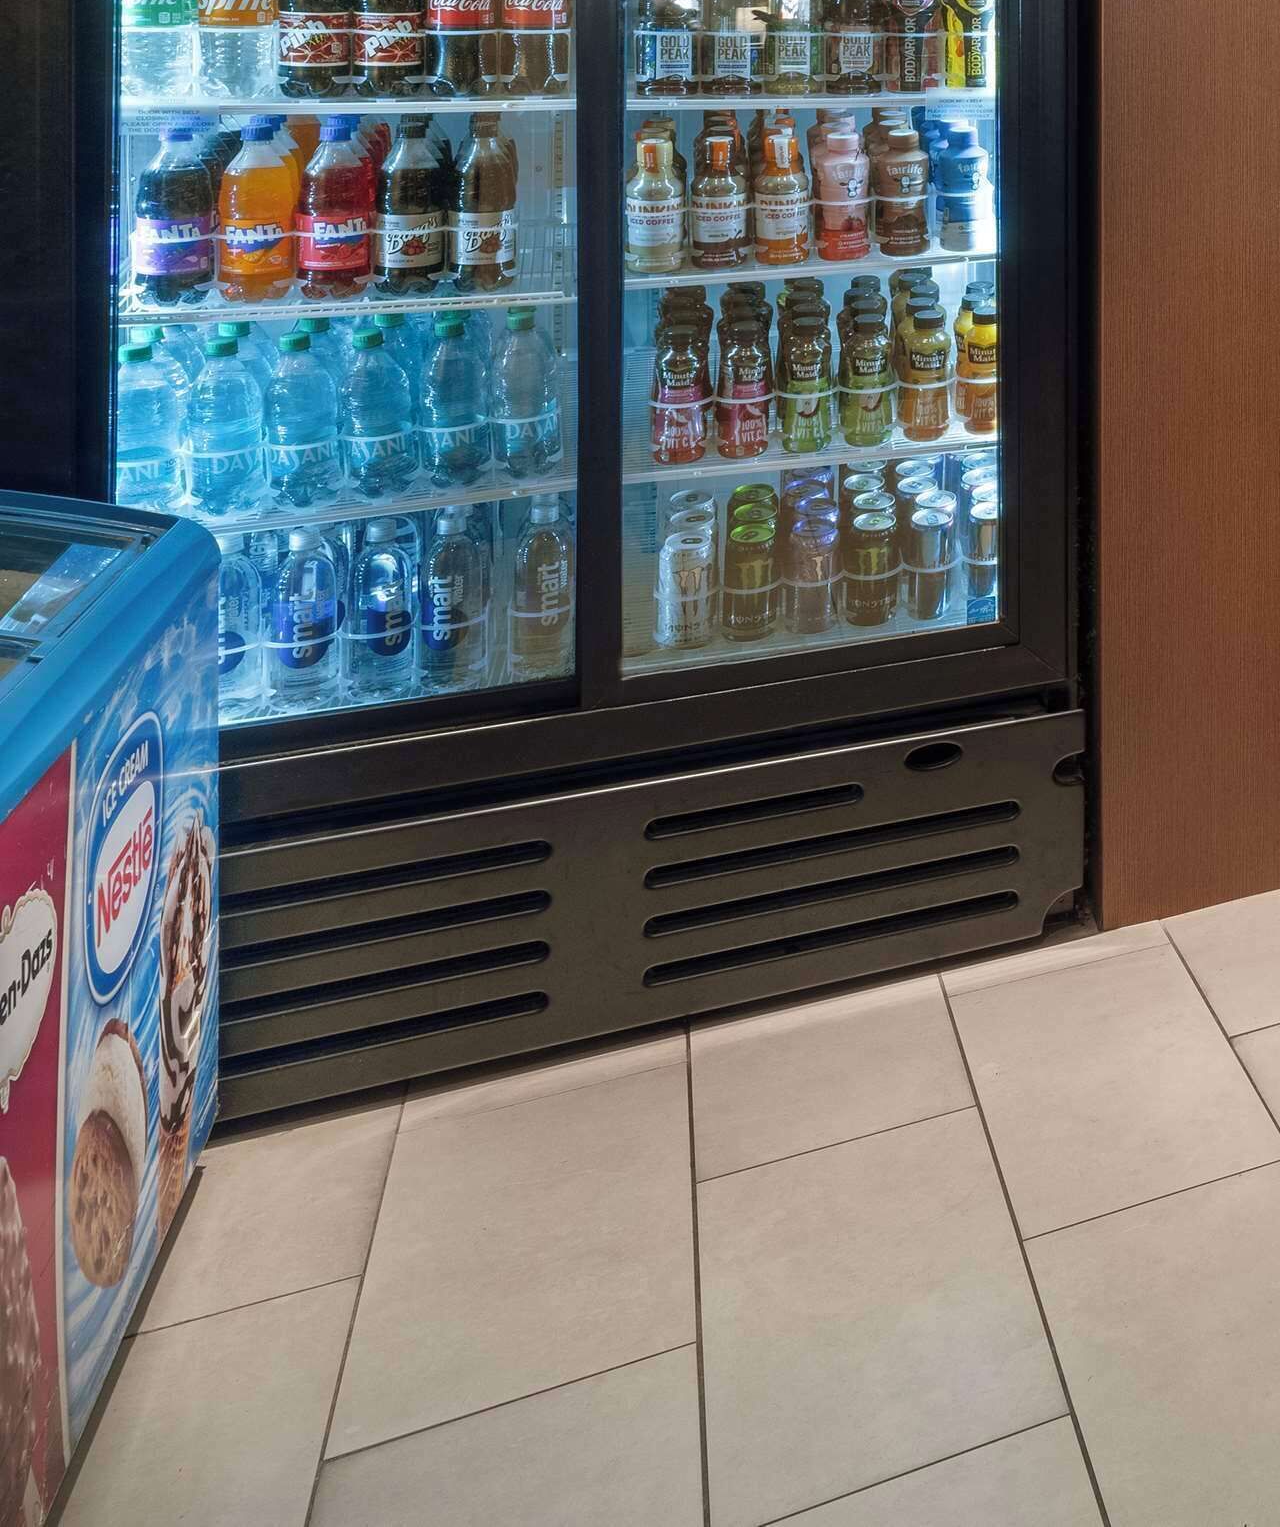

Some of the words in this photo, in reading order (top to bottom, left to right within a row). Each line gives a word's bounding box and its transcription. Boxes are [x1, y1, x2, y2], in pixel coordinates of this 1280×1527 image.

[659, 34, 690, 48] GOLD
[717, 35, 747, 48] GOLD
[659, 47, 690, 61] PEAK
[717, 48, 747, 61] PEAK
[777, 44, 807, 58] PEAK
[841, 44, 872, 58] PEAK
[887, 162, 924, 176] fairlife
[645, 216, 675, 225] COFFEE
[709, 212, 742, 223] COFFEE
[313, 219, 366, 240] FANTA
[666, 378, 693, 388] Maid
[741, 418, 765, 431] 100%
[741, 429, 757, 442] VIT
[560, 559, 568, 590] water
[538, 560, 561, 627] smart
[431, 574, 452, 642] smart
[102, 789, 118, 828] ICE
[117, 739, 149, 798] CREAM
[96, 805, 154, 949] Nestlé
